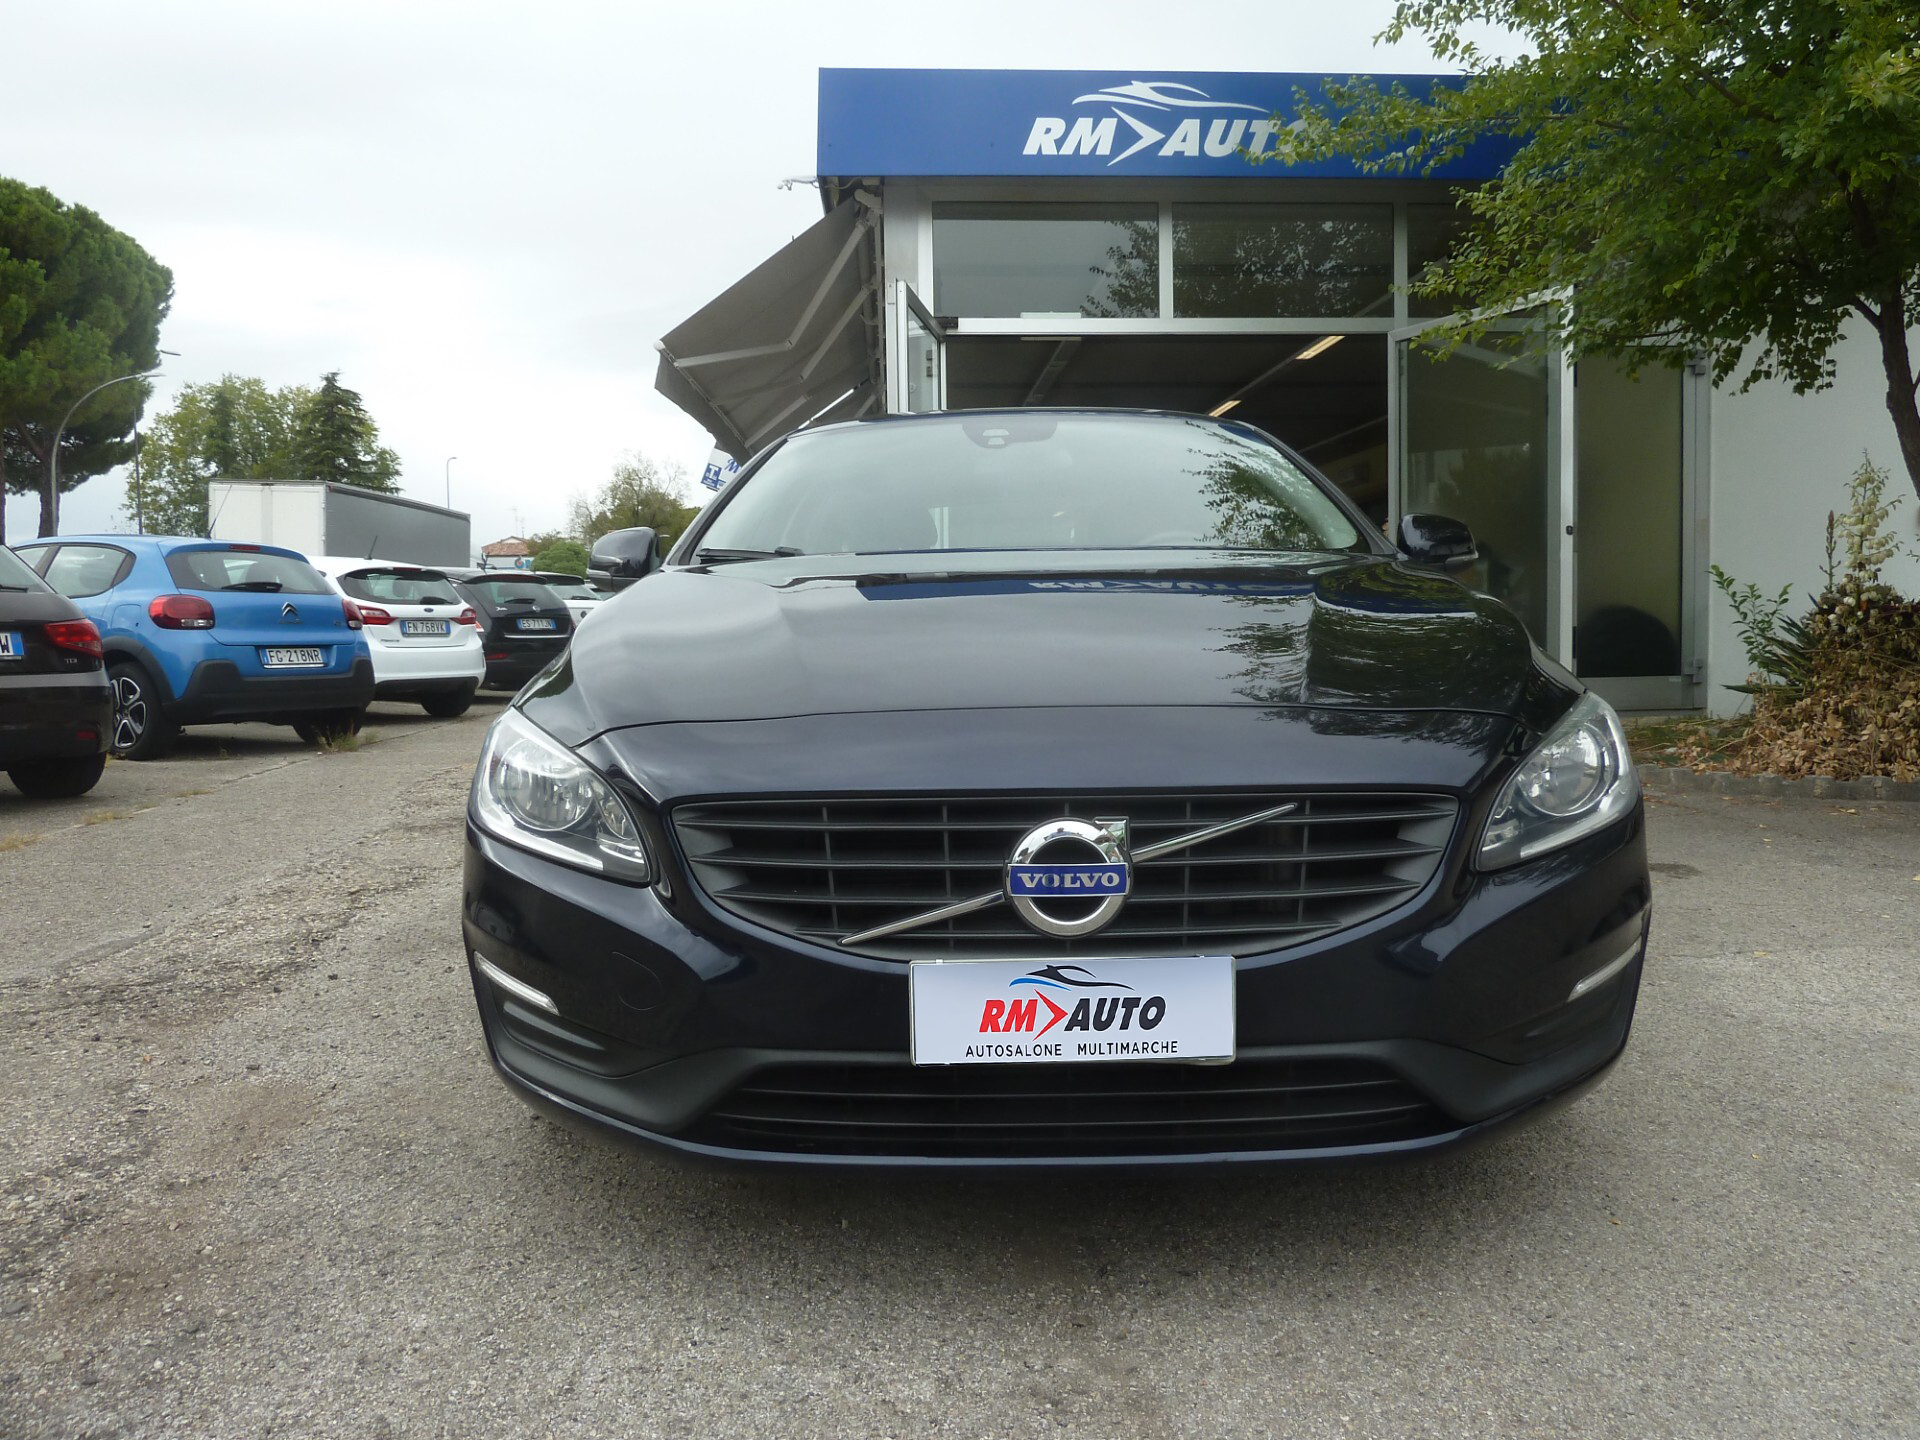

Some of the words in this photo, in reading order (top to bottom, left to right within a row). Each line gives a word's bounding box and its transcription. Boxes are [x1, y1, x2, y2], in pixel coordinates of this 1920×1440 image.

[1022, 117, 1116, 155] RM
[407, 622, 418, 632] FN
[420, 622, 445, 632] 768VK
[268, 650, 283, 662] FG
[288, 650, 320, 662] 218NR
[1017, 872, 1120, 888] VOLVO
[979, 999, 1038, 1033] RM
[1064, 996, 1166, 1031] AUTO
[966, 1044, 1062, 1057] AUTOSALONE
[1077, 1041, 1178, 1055] MULTIMARCHE
